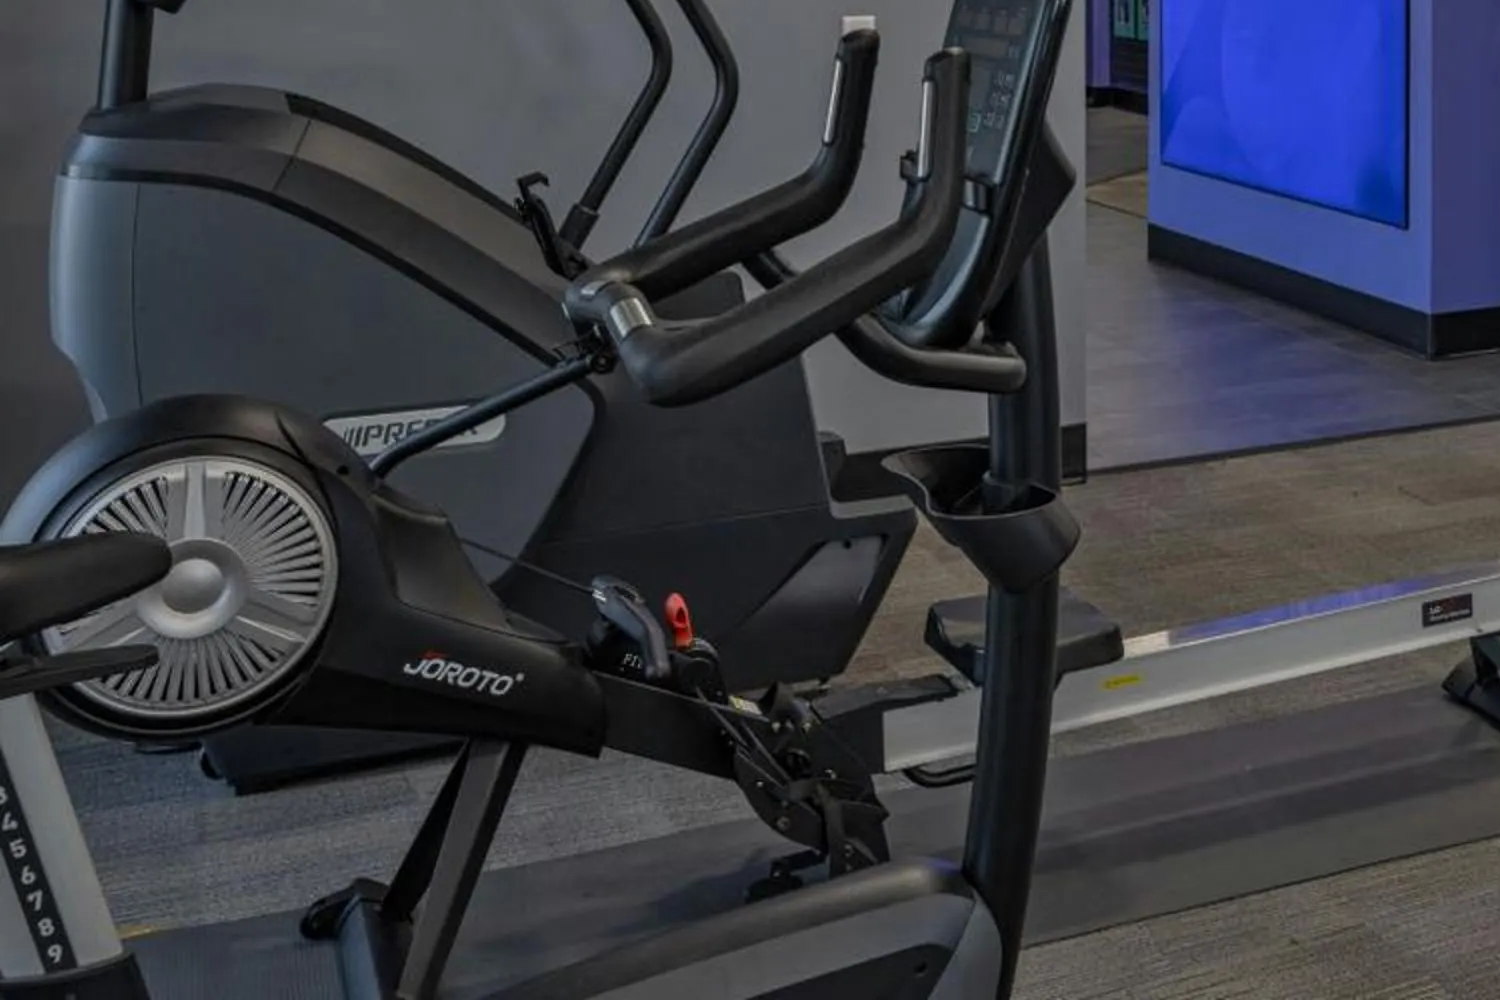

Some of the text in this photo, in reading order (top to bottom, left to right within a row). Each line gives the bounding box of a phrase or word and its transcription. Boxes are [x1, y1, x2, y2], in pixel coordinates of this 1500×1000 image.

[403, 657, 515, 696] JOROTO
[2, 812, 17, 831] 4
[9, 839, 26, 858] 5
[20, 865, 35, 885] 6
[27, 891, 42, 911] 7
[37, 918, 54, 936] 8
[47, 944, 62, 964] 9
